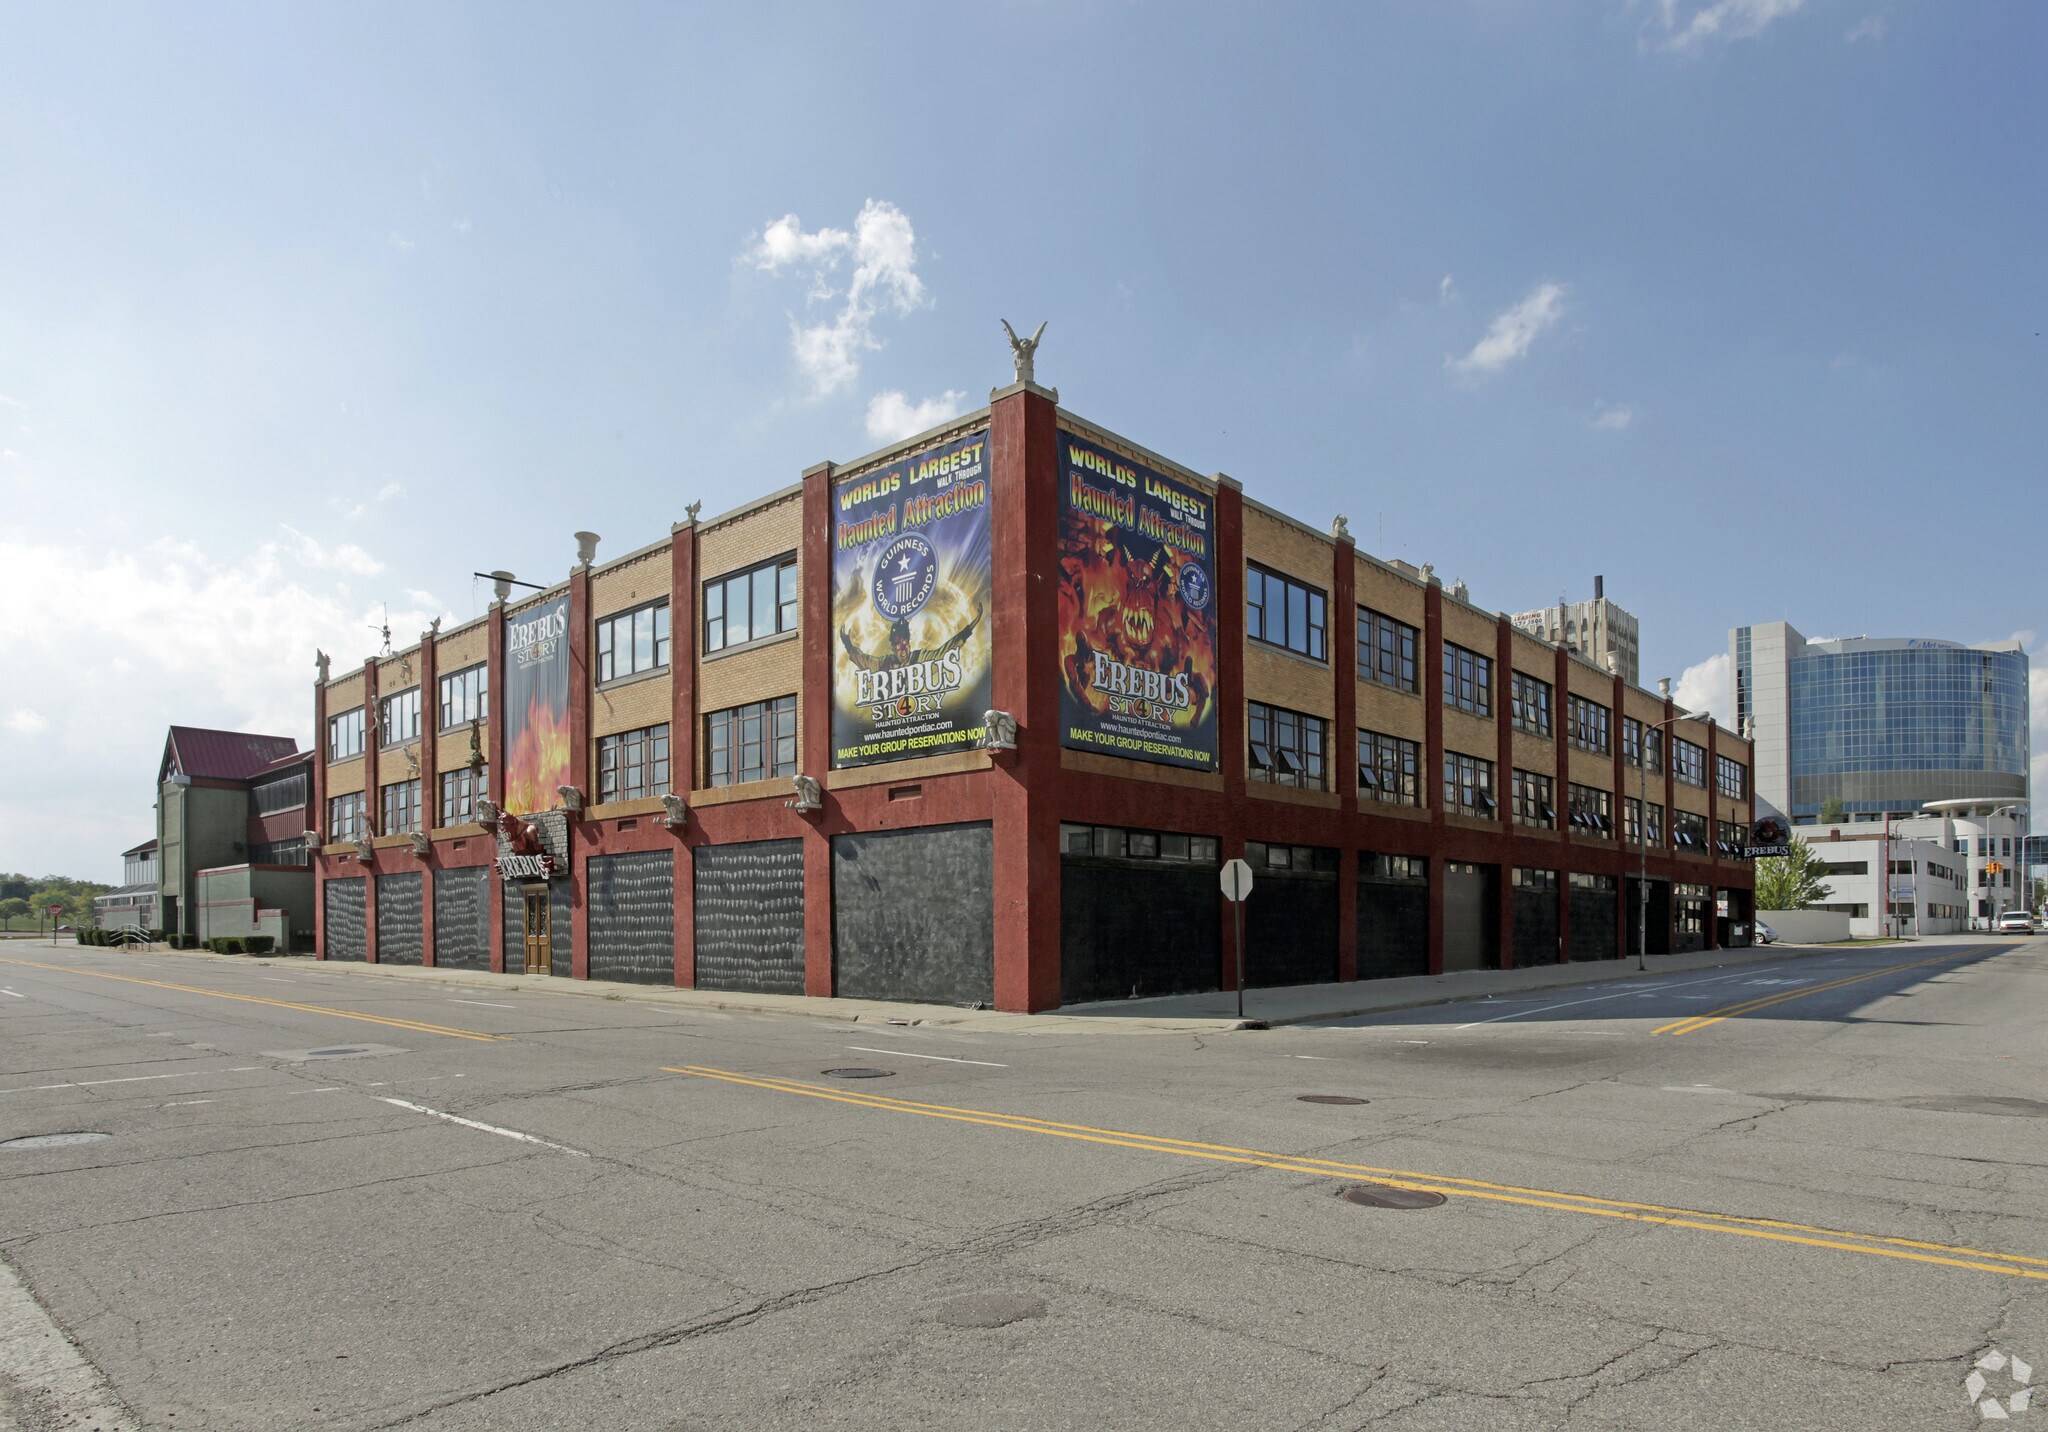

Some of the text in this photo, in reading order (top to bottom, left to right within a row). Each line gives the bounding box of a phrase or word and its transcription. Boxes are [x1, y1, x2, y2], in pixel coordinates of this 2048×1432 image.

[909, 442, 984, 485] LARGEST
[937, 463, 982, 489] WALK THROUGH
[1145, 475, 1206, 520] LARGEST
[837, 480, 985, 551] Haunted Attraction
[1070, 472, 1206, 559] Haunted Attraction
[881, 539, 929, 569] GUINNESS
[876, 564, 934, 615] WORLD RECORDS
[509, 603, 566, 652] EREBUS
[1514, 612, 1541, 622] LEASING
[855, 647, 962, 706] EREBUS
[1092, 650, 1190, 708] EREBUS
[864, 719, 953, 742] www.hauntedpontiac.com
[875, 712, 940, 729] HAUNTED ATTRACTION
[1100, 721, 1182, 744] www.hauntedpontiac.com
[1112, 713, 1171, 731] HAUNTED ATTRACTION
[837, 726, 987, 759] MAKE YOUR GROUP RESERVATIONS NOW
[1070, 728, 1211, 762] MAKE YOUR GROUP RESERVATIONS NOW
[1744, 845, 1789, 857] EREBUS
